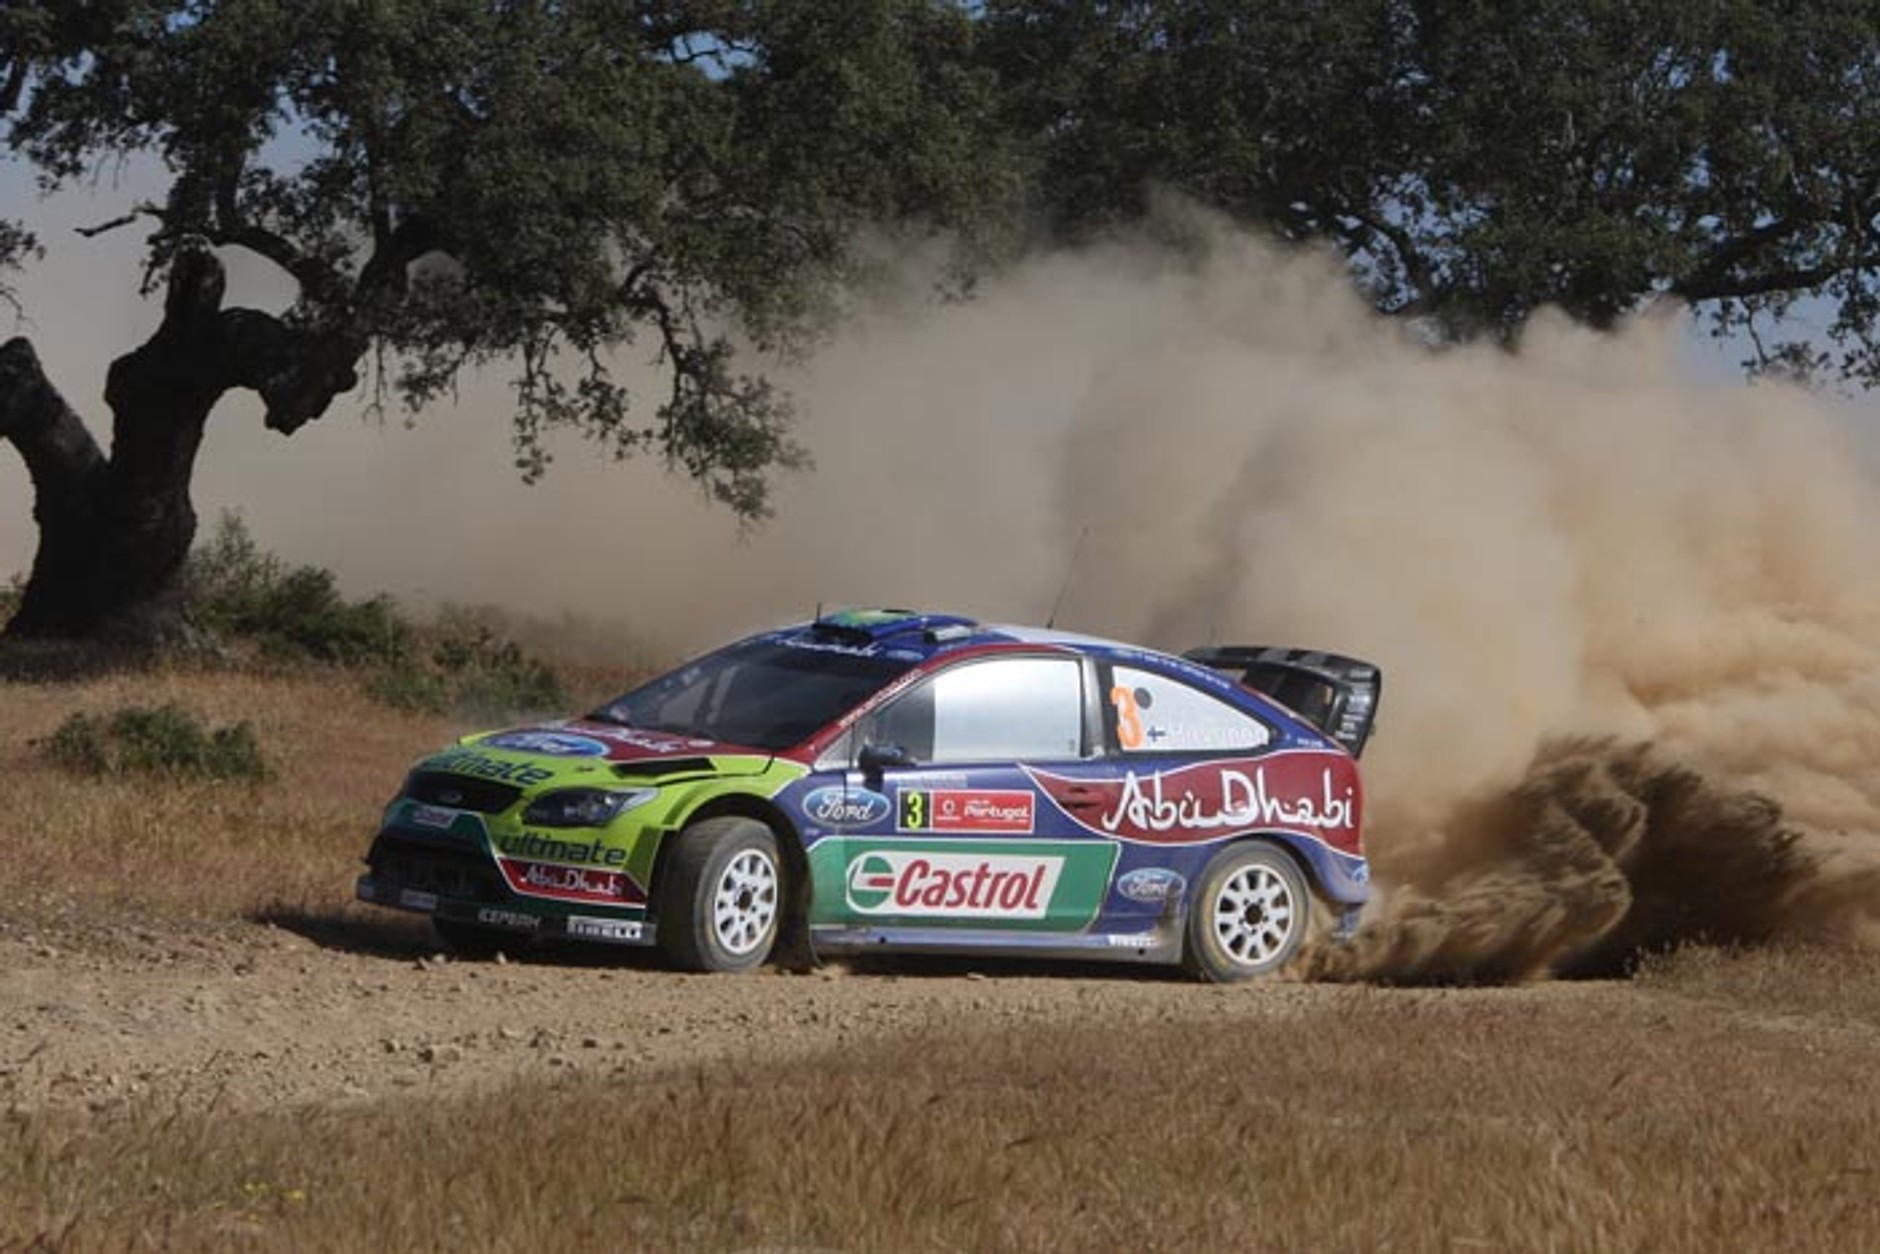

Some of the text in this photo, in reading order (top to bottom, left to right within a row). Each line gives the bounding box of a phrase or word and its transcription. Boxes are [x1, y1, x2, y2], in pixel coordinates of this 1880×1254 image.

[1111, 687, 1143, 748] 3
[816, 793, 874, 820] Ford
[907, 792, 923, 829] 3
[964, 803, 1029, 821] Portugal
[1218, 767, 1354, 829] Dhabi
[501, 830, 627, 865] ultimate
[895, 859, 1047, 910] Castrol
